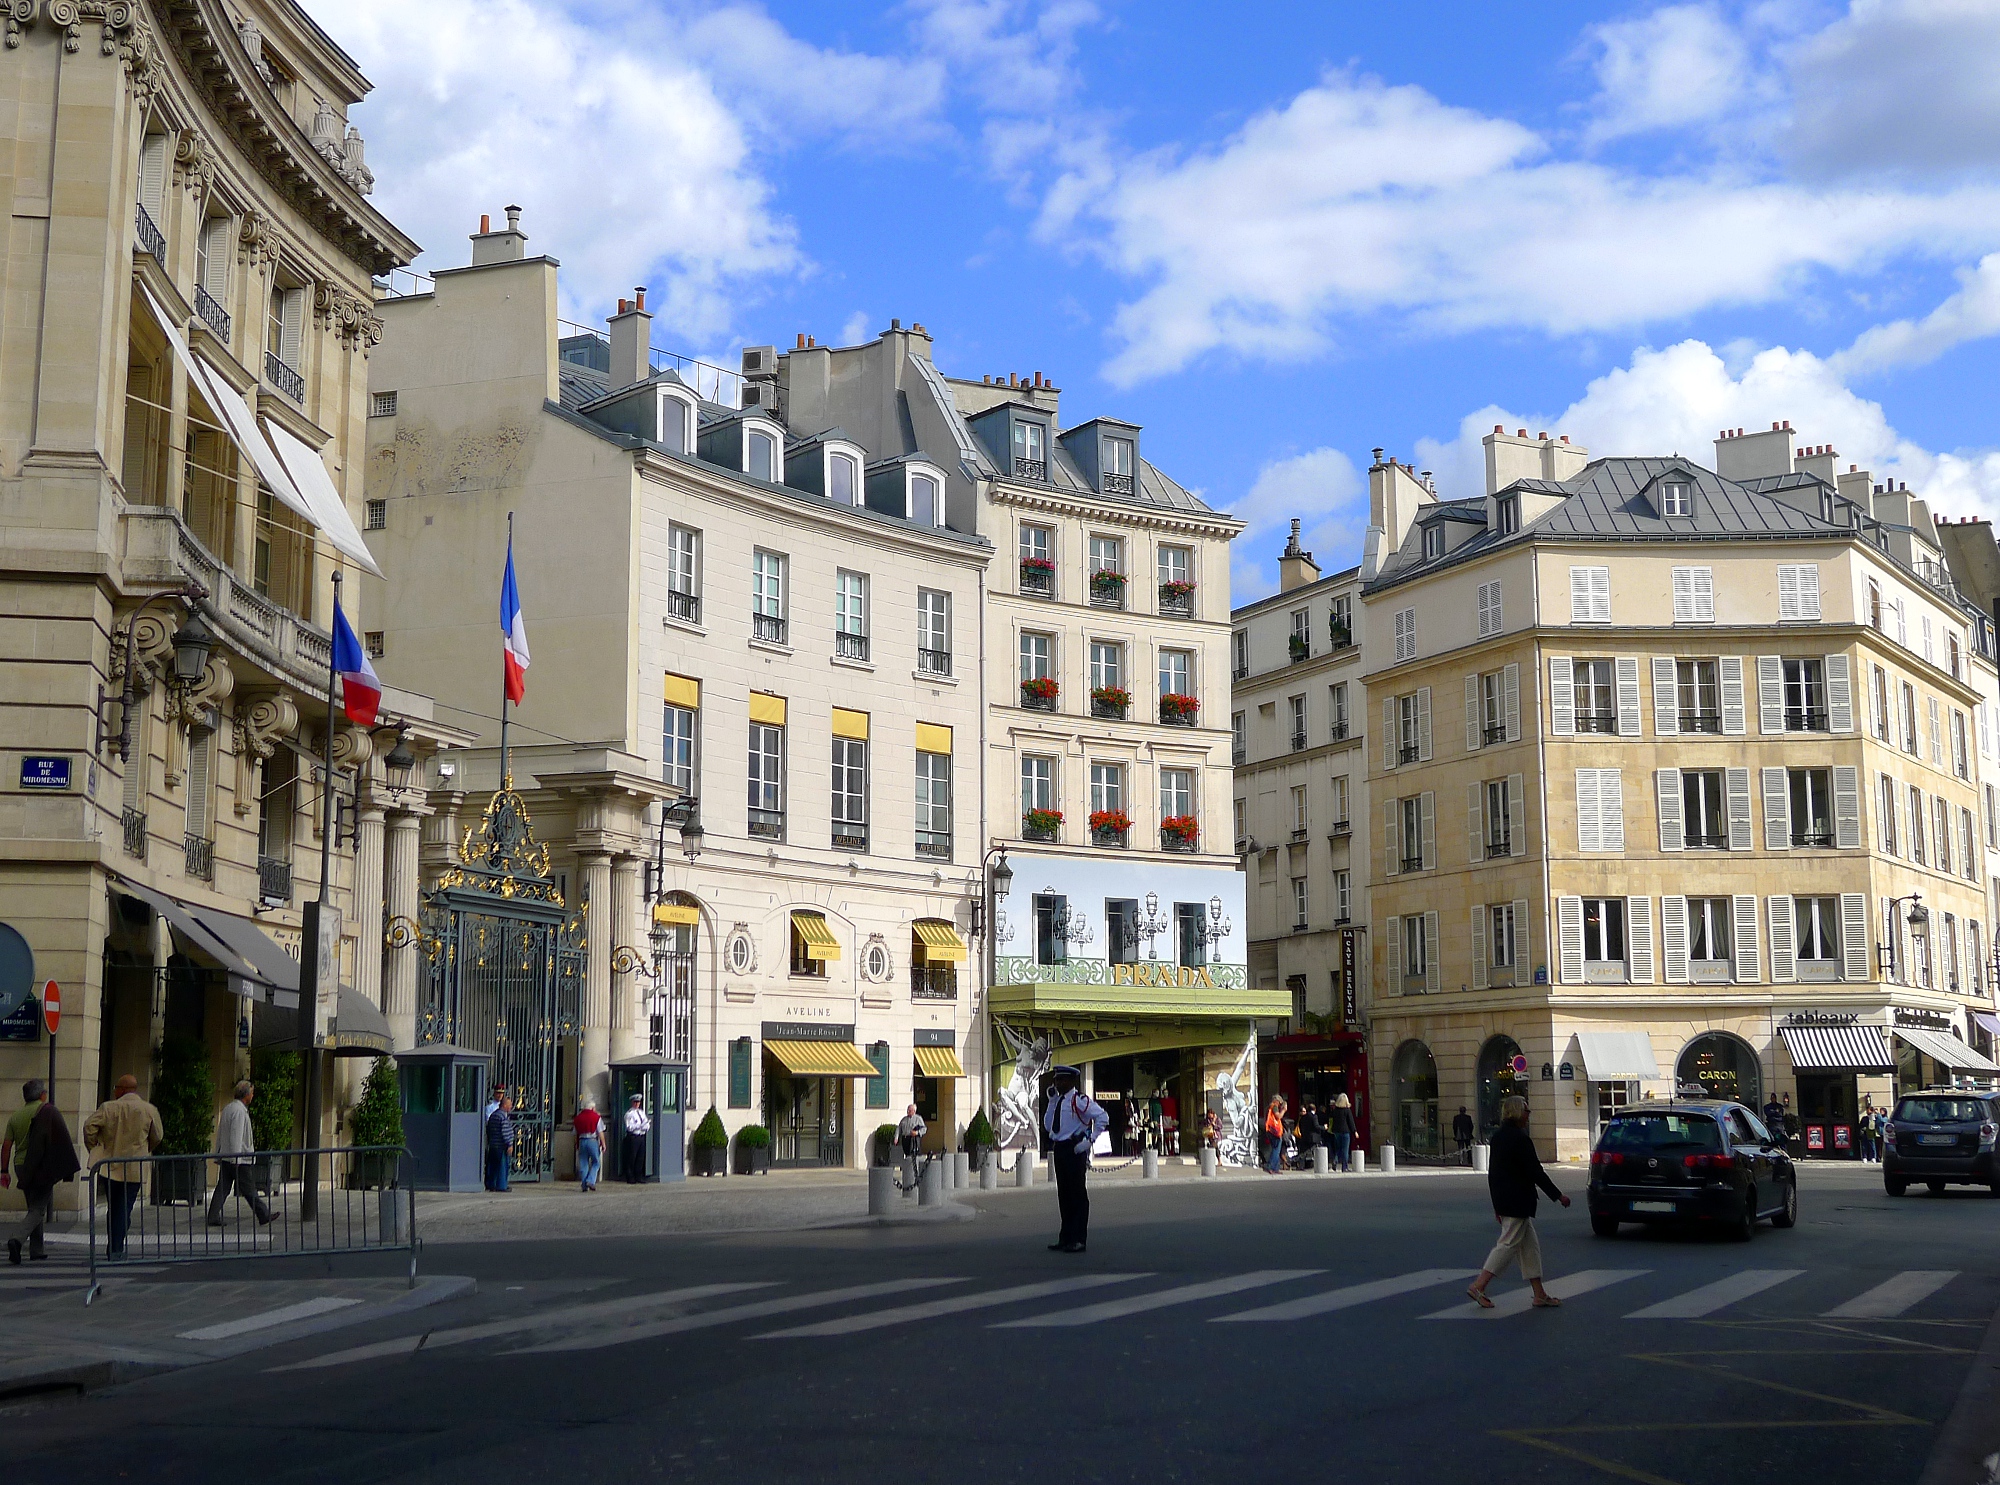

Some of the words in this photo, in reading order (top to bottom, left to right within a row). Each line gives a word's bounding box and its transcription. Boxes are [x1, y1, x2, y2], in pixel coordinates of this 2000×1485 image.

[23, 776, 68, 784] MIROMESNIL
[752, 823, 777, 833] AVELINE
[835, 836, 862, 845] AVELINE
[920, 843, 946, 854] AVELINE
[1590, 968, 1622, 976] CARON
[1803, 966, 1835, 974] CARON
[1114, 963, 1214, 989] PRADA
[786, 1007, 831, 1016] AVELINE
[1787, 1010, 1859, 1025] tableaux
[1699, 1070, 1736, 1080] CARON
